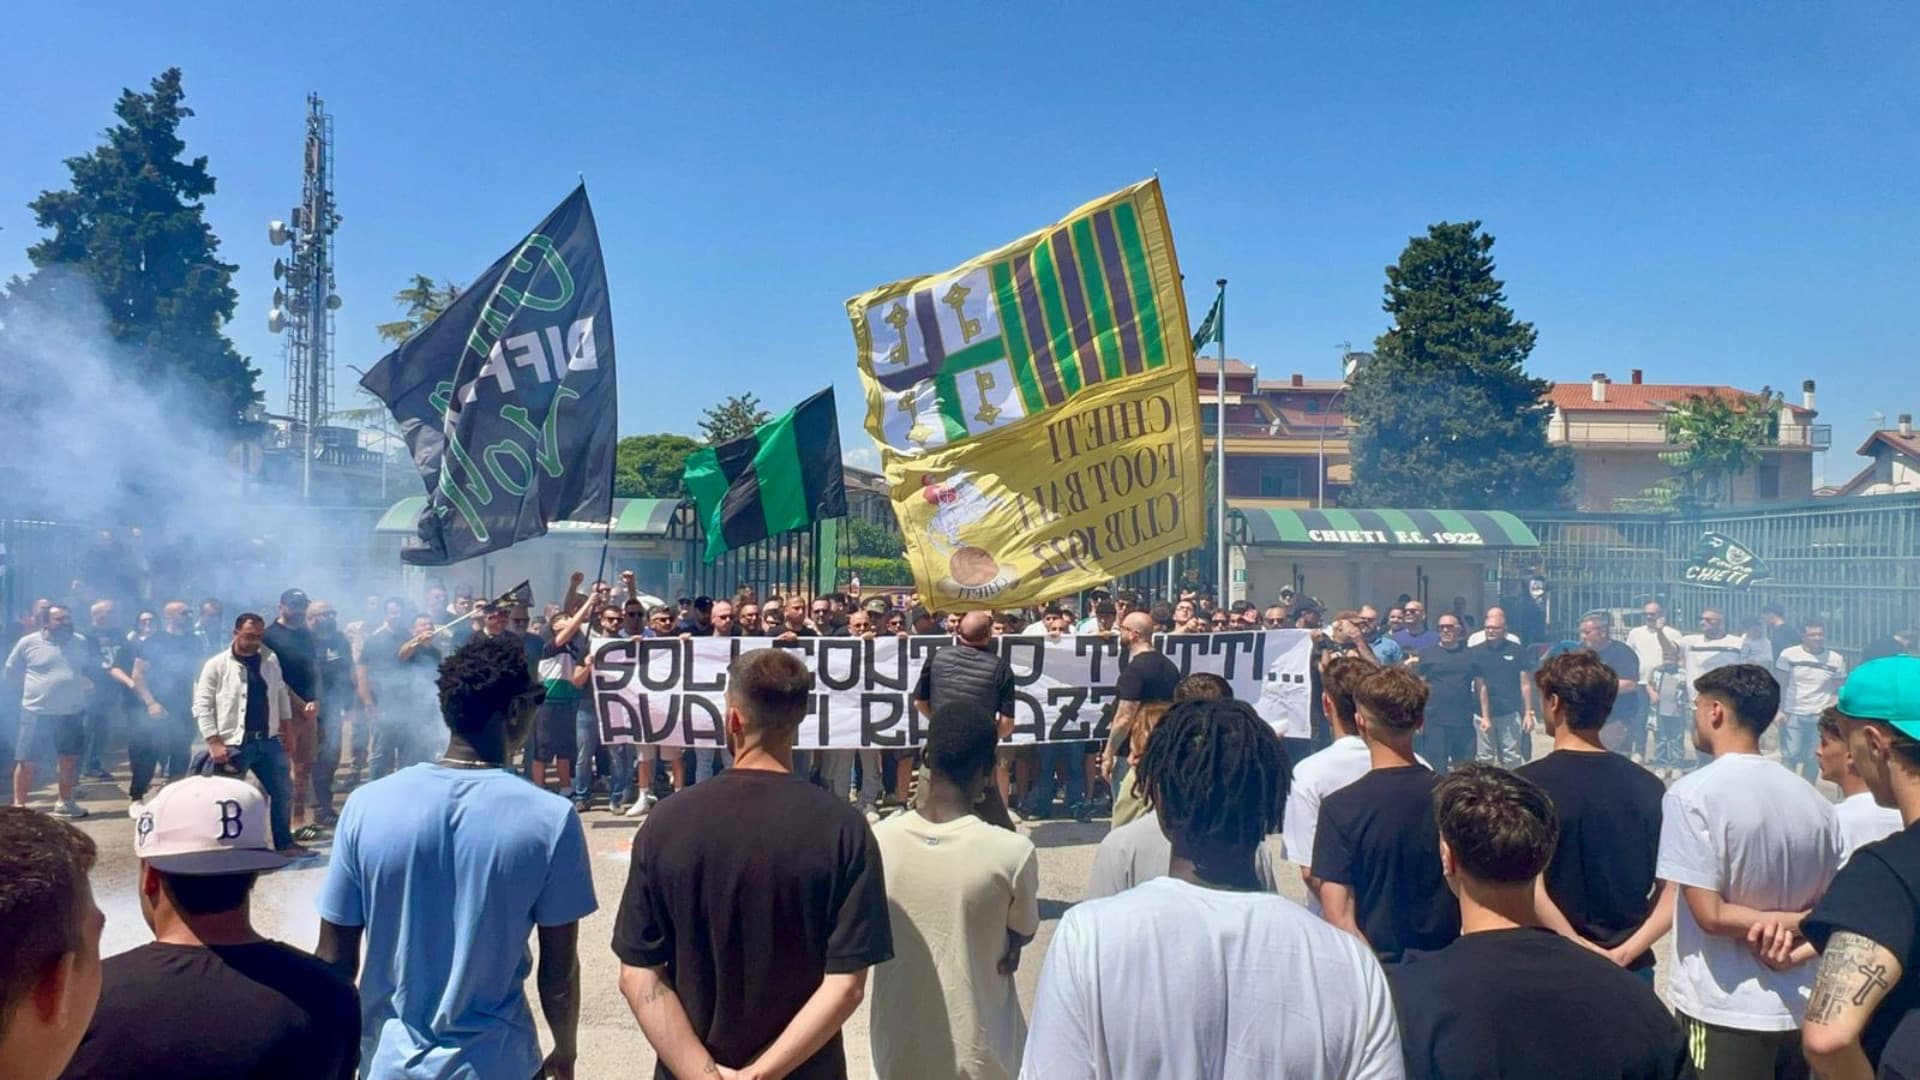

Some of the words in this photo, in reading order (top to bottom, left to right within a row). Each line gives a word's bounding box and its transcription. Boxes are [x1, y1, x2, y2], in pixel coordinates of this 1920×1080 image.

[1308, 529, 1388, 544] CHIETI
[1395, 531, 1430, 545] F.C.
[1432, 532, 1484, 545] 1922
[1685, 565, 1749, 585] CHIETI
[216, 799, 243, 840] B
